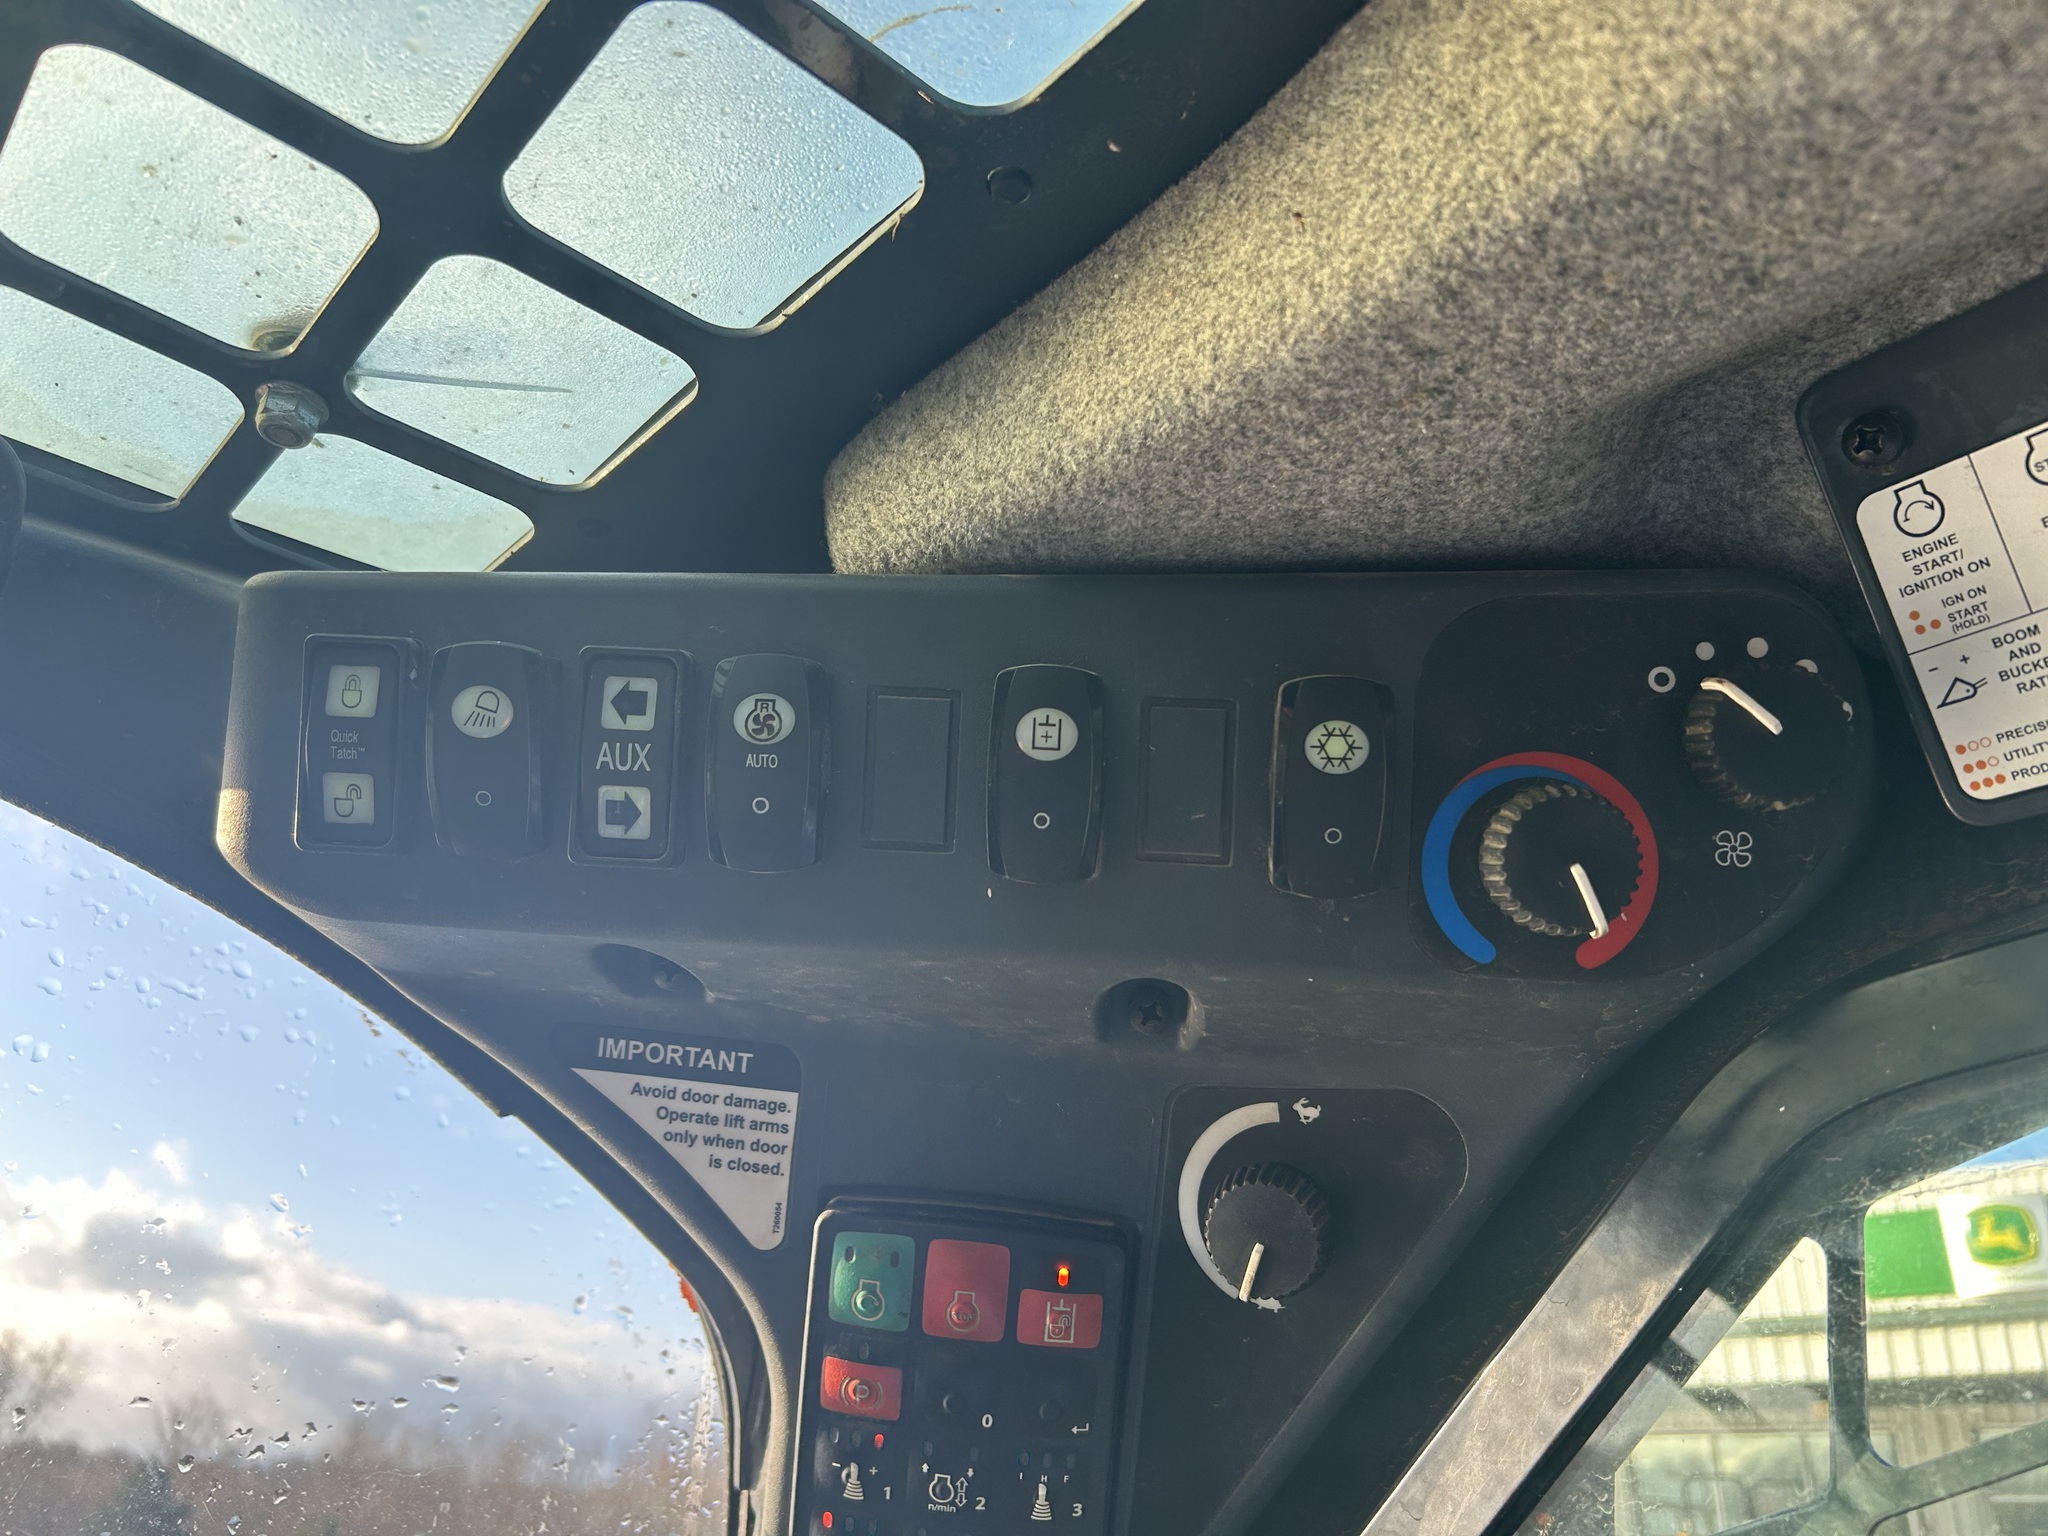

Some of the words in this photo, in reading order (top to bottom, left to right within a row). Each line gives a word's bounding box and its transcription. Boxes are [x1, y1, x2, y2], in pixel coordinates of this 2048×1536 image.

[1902, 533, 1959, 562] ENGINE
[1912, 548, 1964, 576] START/
[1899, 566, 1964, 598] IGNITION
[1967, 557, 1991, 573] ON
[1941, 593, 1965, 608] IGN
[1967, 585, 1987, 599] ON
[1947, 601, 1989, 623] START
[1952, 613, 1991, 634] (HOLD)
[1991, 624, 2041, 649] BOOM
[2009, 642, 2042, 661] AND
[331, 729, 359, 743] Quick
[595, 741, 652, 772] AUX
[745, 753, 779, 768] AUTO
[598, 1037, 753, 1074] IMPORTANT
[630, 1082, 677, 1101] Avoid
[682, 1088, 719, 1105] door
[723, 1093, 792, 1115] damage.
[656, 1105, 719, 1126] Operate
[724, 1114, 745, 1129] lift
[749, 1120, 789, 1134] arms
[663, 1130, 698, 1147] only
[703, 1134, 745, 1150] when
[750, 1138, 788, 1155] door
[709, 1155, 722, 1169] is
[727, 1157, 785, 1177] closed.
[1040, 1475, 1048, 1483] H
[1063, 1475, 1070, 1483] F
[883, 1486, 892, 1500] 1
[975, 1496, 986, 1510] 2
[927, 1502, 957, 1513] n/min
[1072, 1503, 1083, 1517] 3
